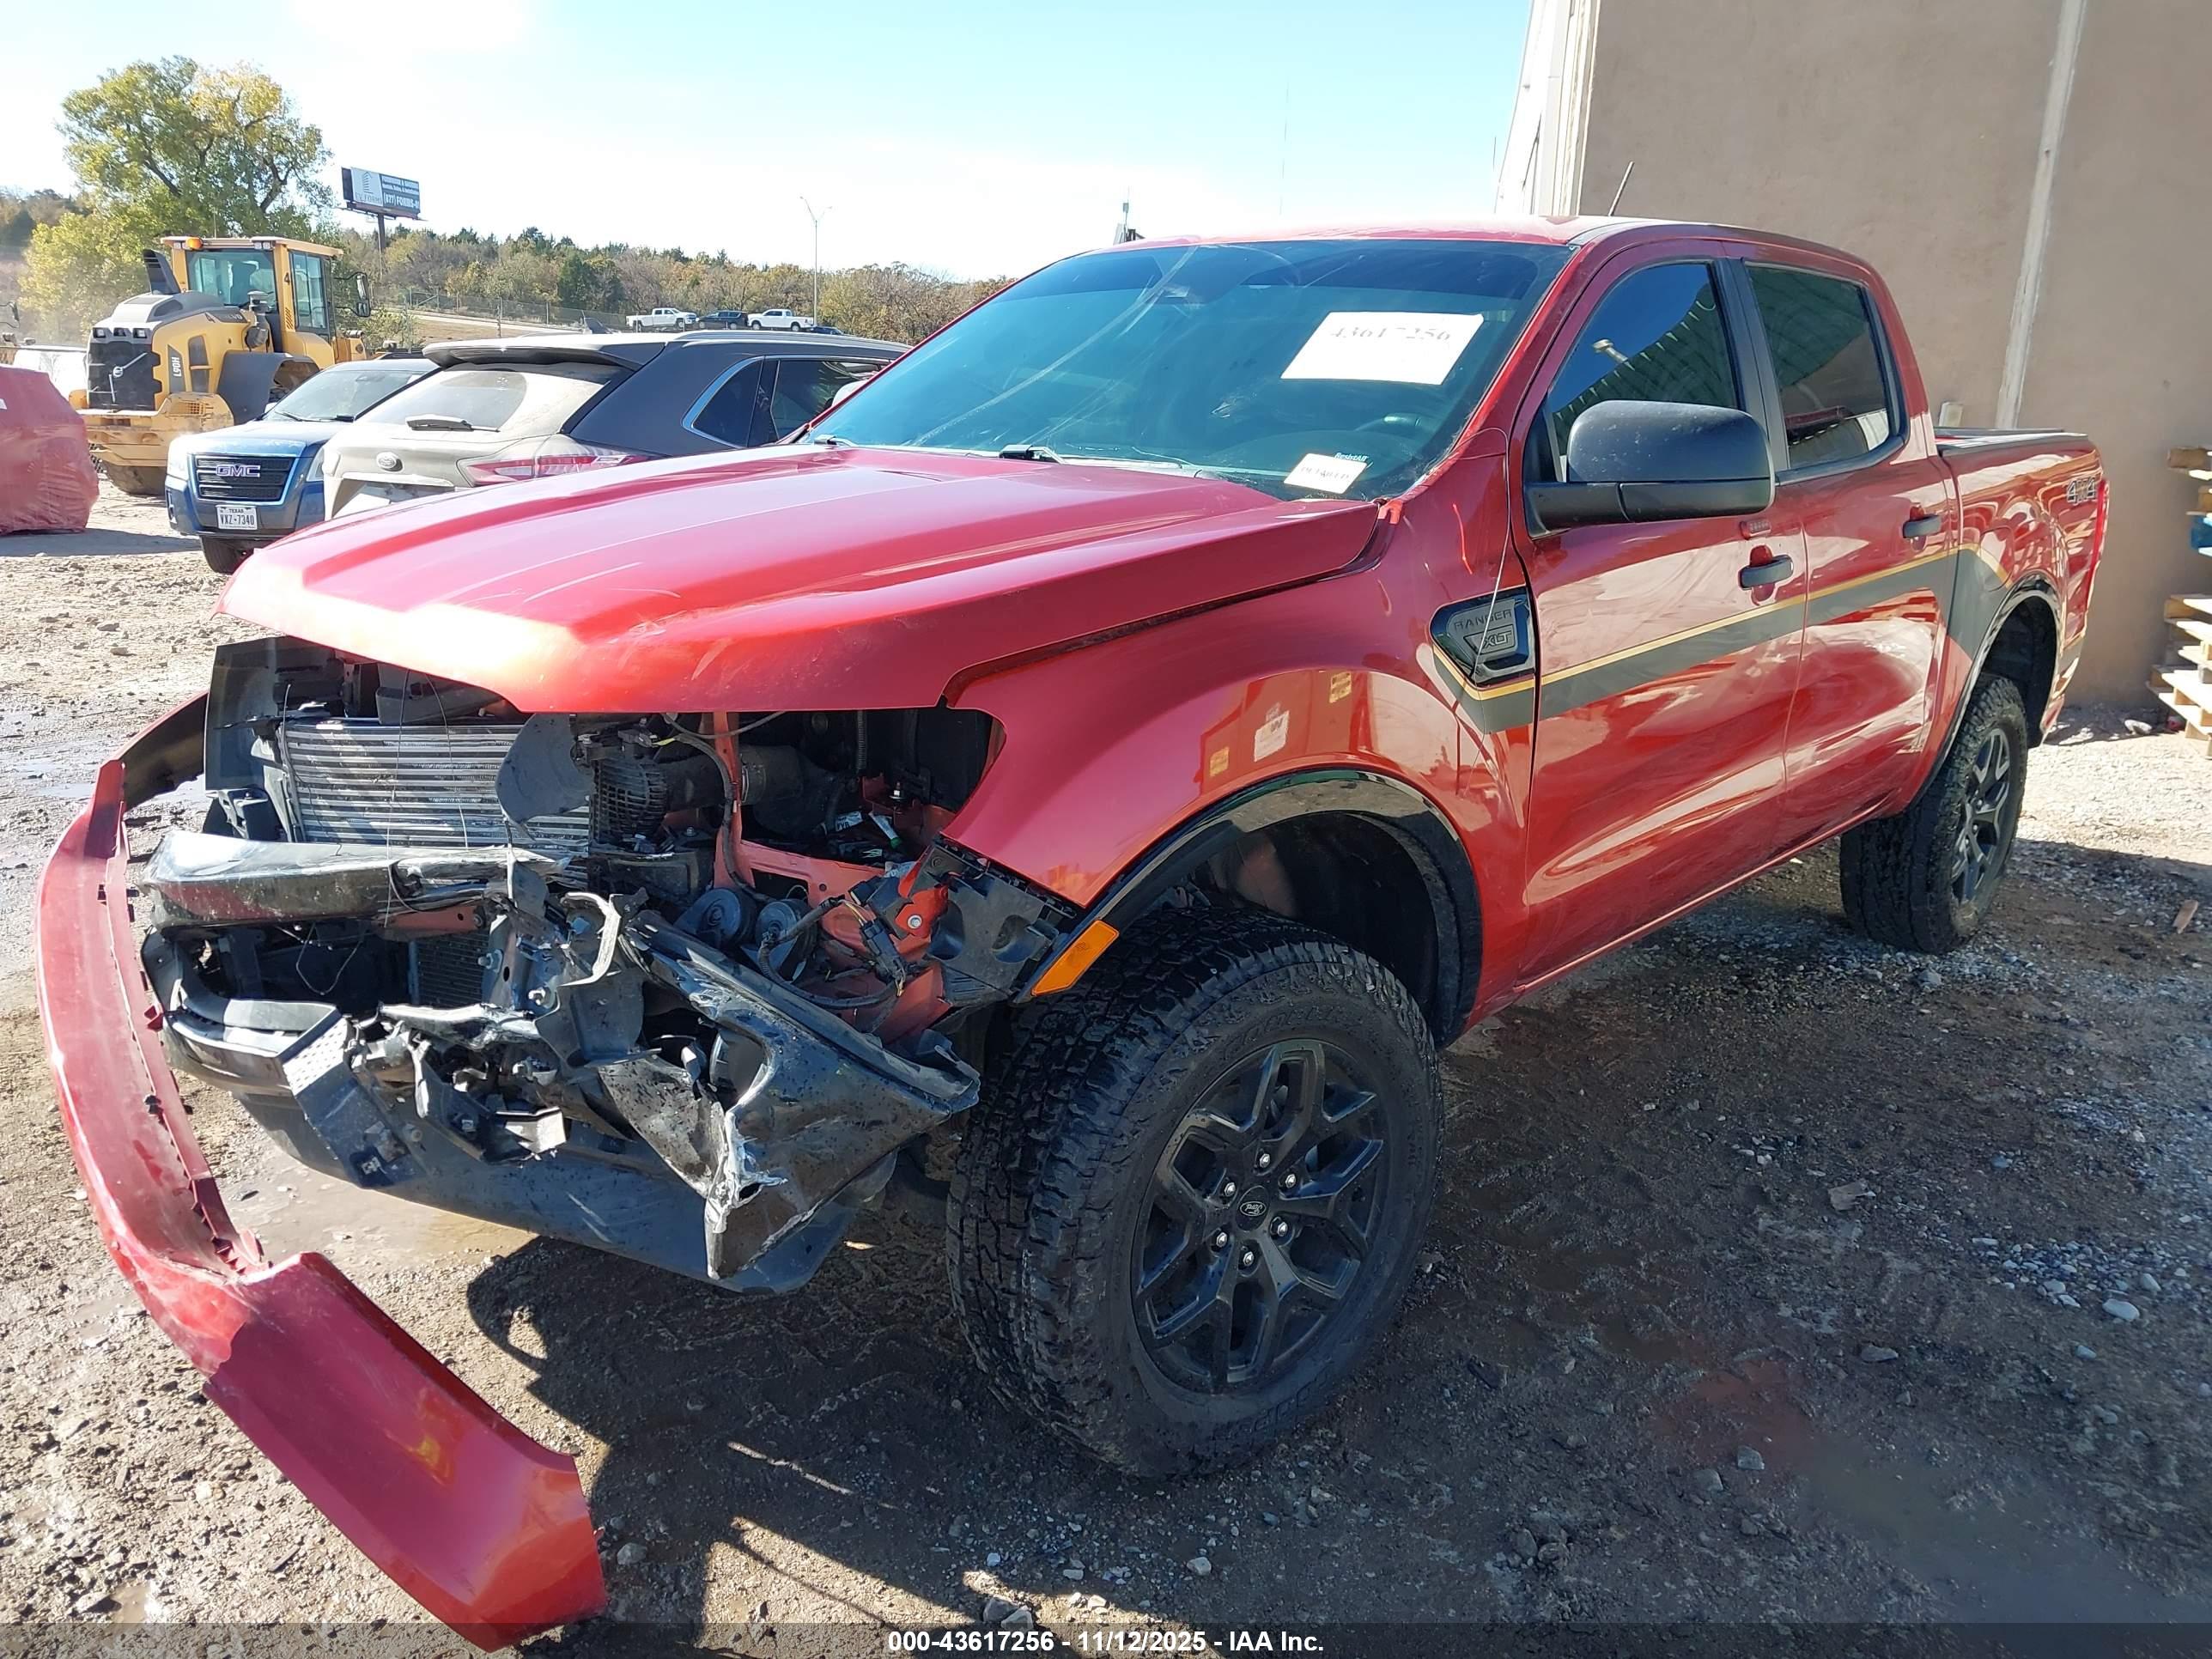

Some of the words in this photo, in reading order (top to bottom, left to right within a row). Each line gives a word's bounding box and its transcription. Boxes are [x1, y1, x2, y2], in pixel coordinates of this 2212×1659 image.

[216, 464, 261, 477] GMC
[1454, 609, 1512, 630] RANGER
[1481, 630, 1511, 649] XLT
[1243, 1203, 1263, 1215] Ford
